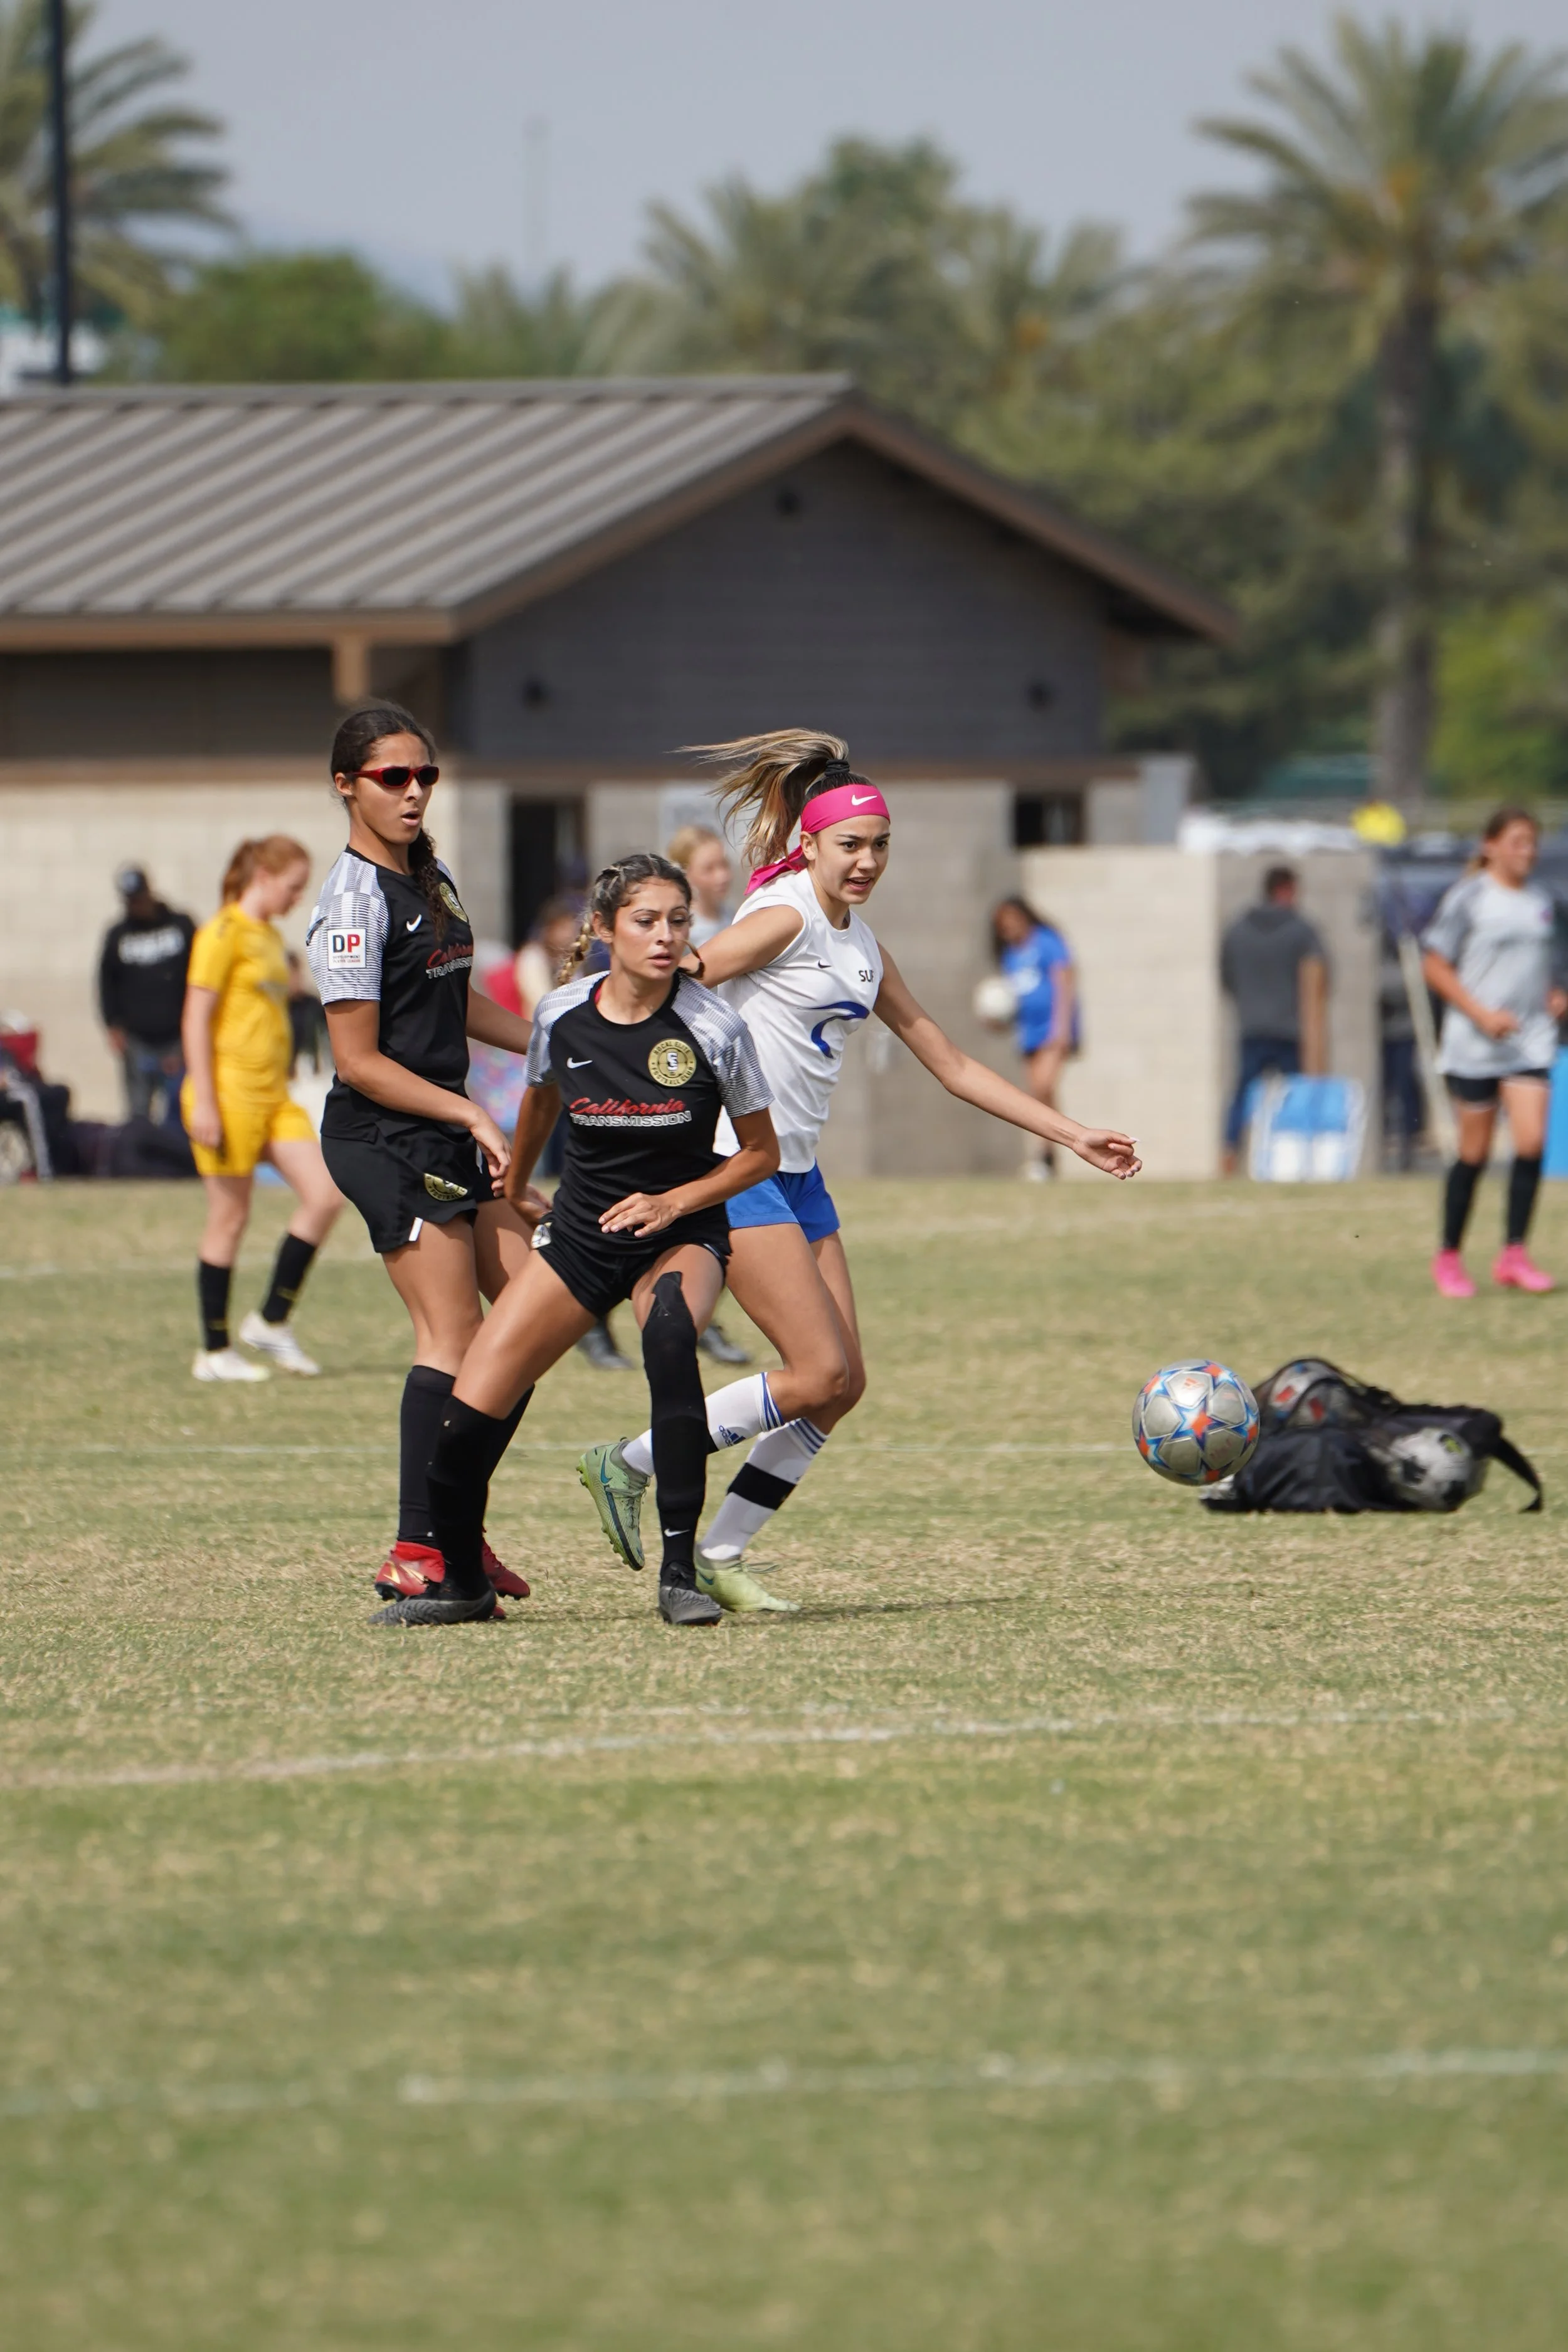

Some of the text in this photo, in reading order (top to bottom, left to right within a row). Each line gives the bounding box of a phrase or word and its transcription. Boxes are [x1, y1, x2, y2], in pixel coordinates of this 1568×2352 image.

[332, 934, 361, 953] DP
[569, 1097, 686, 1116] California
[569, 1110, 692, 1127] TRANSMISSION
